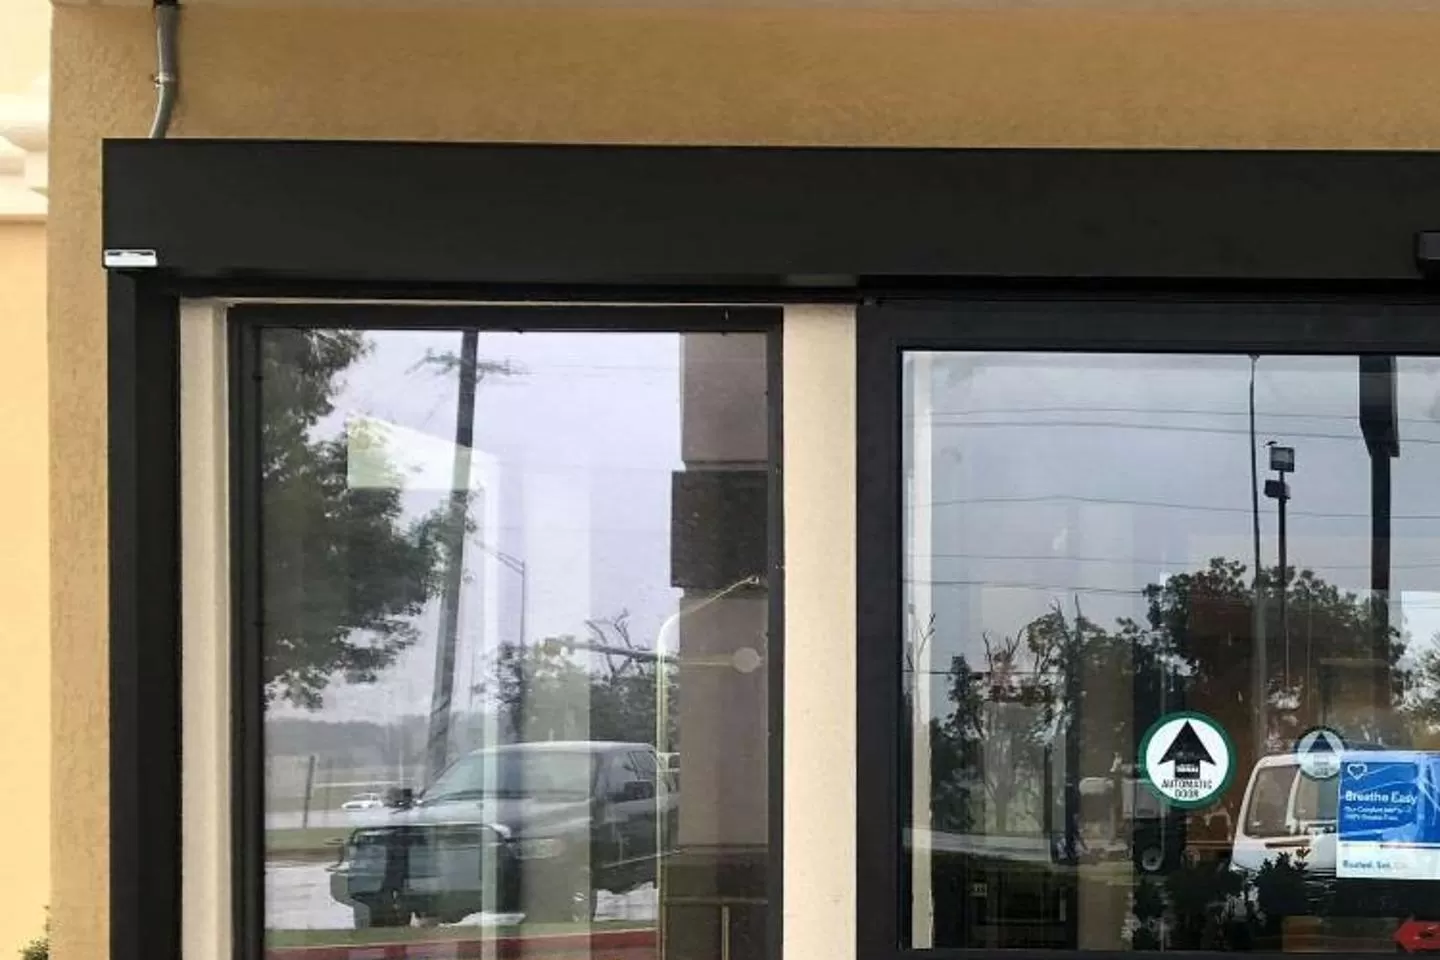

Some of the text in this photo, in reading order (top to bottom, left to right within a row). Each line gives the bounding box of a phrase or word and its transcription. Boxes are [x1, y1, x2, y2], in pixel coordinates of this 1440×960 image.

[1161, 779, 1213, 789] AUTOMATIC
[1174, 789, 1200, 798] DOOR
[1345, 790, 1418, 805] Breathe Easy
